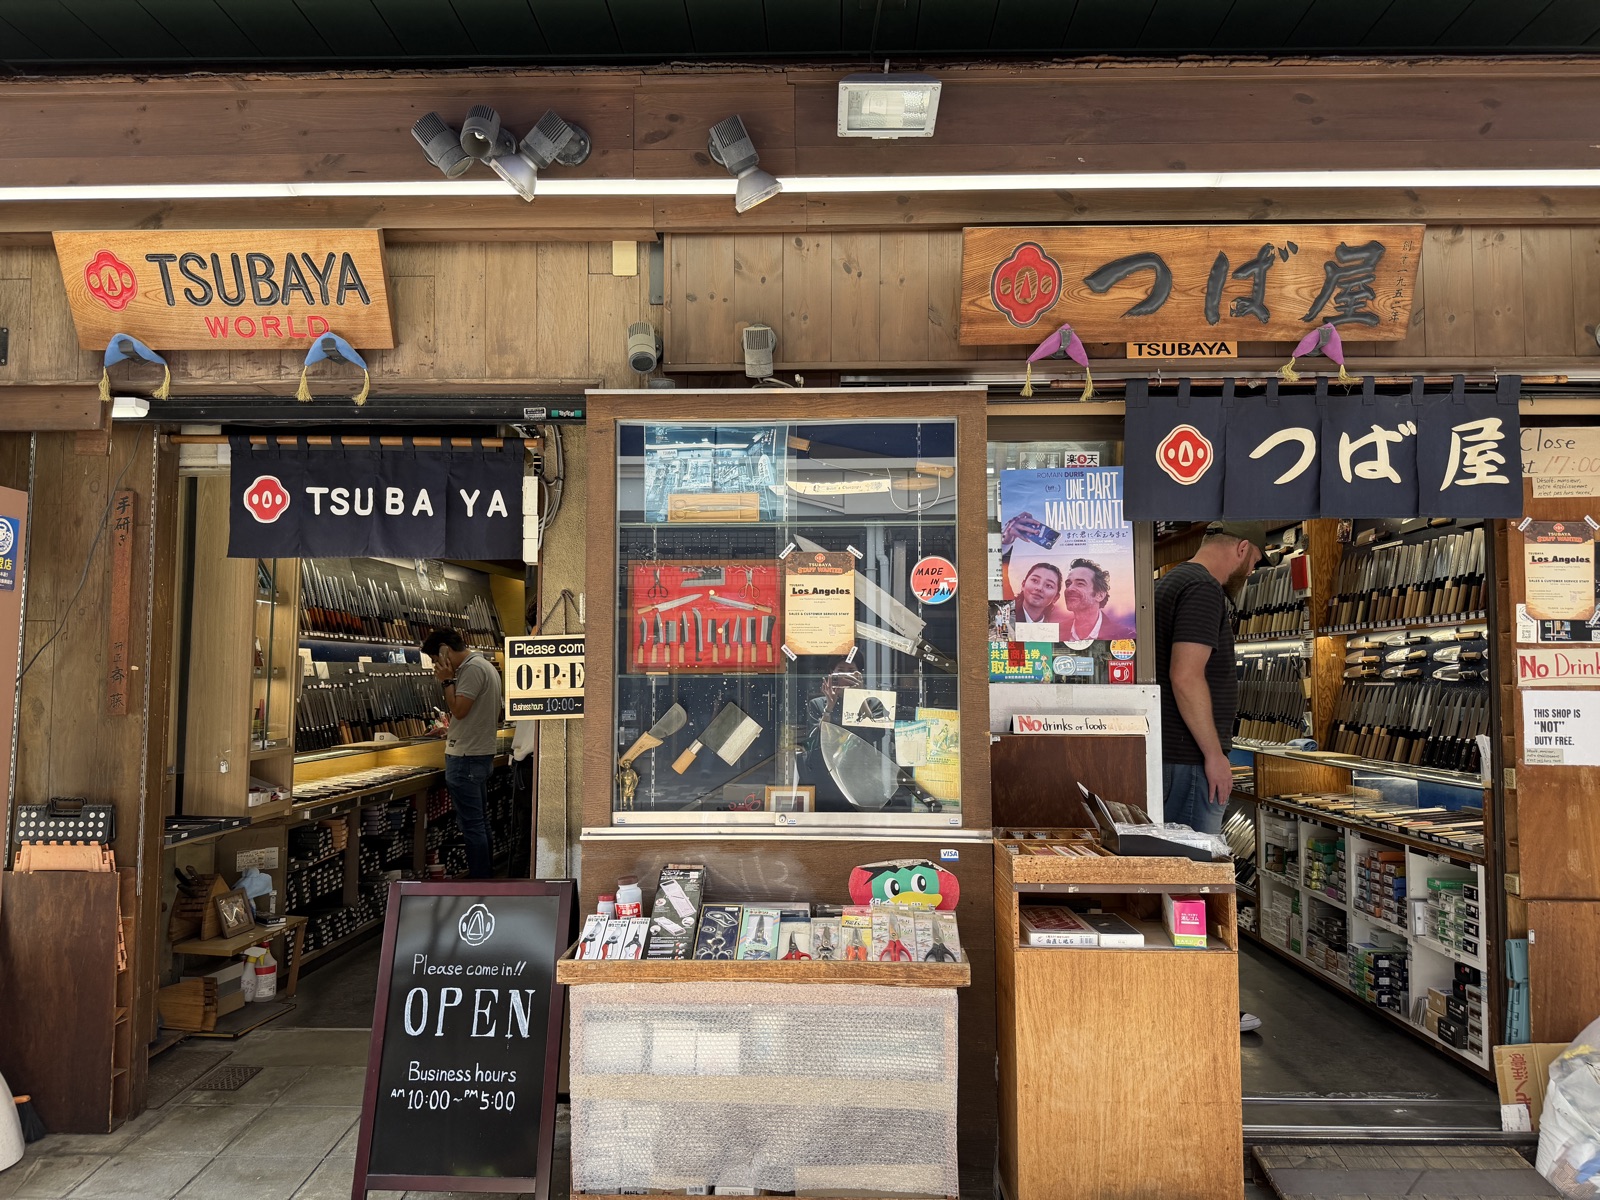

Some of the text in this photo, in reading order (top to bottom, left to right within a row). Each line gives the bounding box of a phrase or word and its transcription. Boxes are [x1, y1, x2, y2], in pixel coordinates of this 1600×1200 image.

[145, 252, 371, 307] TSUBAYA
[1082, 240, 1386, 326] つば屋
[204, 315, 330, 339] WORLD
[1132, 342, 1232, 357] TSUBAYA
[1520, 428, 1576, 452] Close
[1249, 417, 1509, 491] つば屋
[1065, 471, 1119, 500] UNE PART
[1531, 555, 1591, 564] Los Angeles
[916, 567, 943, 576] MADE
[792, 587, 851, 596] Los Angeles
[920, 587, 954, 597] JAPAN
[514, 643, 556, 656] Please
[1519, 654, 1549, 679] No
[1018, 715, 1042, 732] No
[1042, 718, 1073, 731] drinks
[1084, 717, 1107, 731] foods
[1533, 708, 1581, 718] THIS SHOP IS
[1534, 736, 1575, 745] DUTY FREE.
[412, 953, 527, 977] Please come in!!
[404, 987, 536, 1039] OPEN
[407, 1060, 517, 1083] Business hours
[390, 1088, 405, 1099] AM
[464, 1089, 478, 1099] PM
[479, 1090, 516, 1112] 5:00
